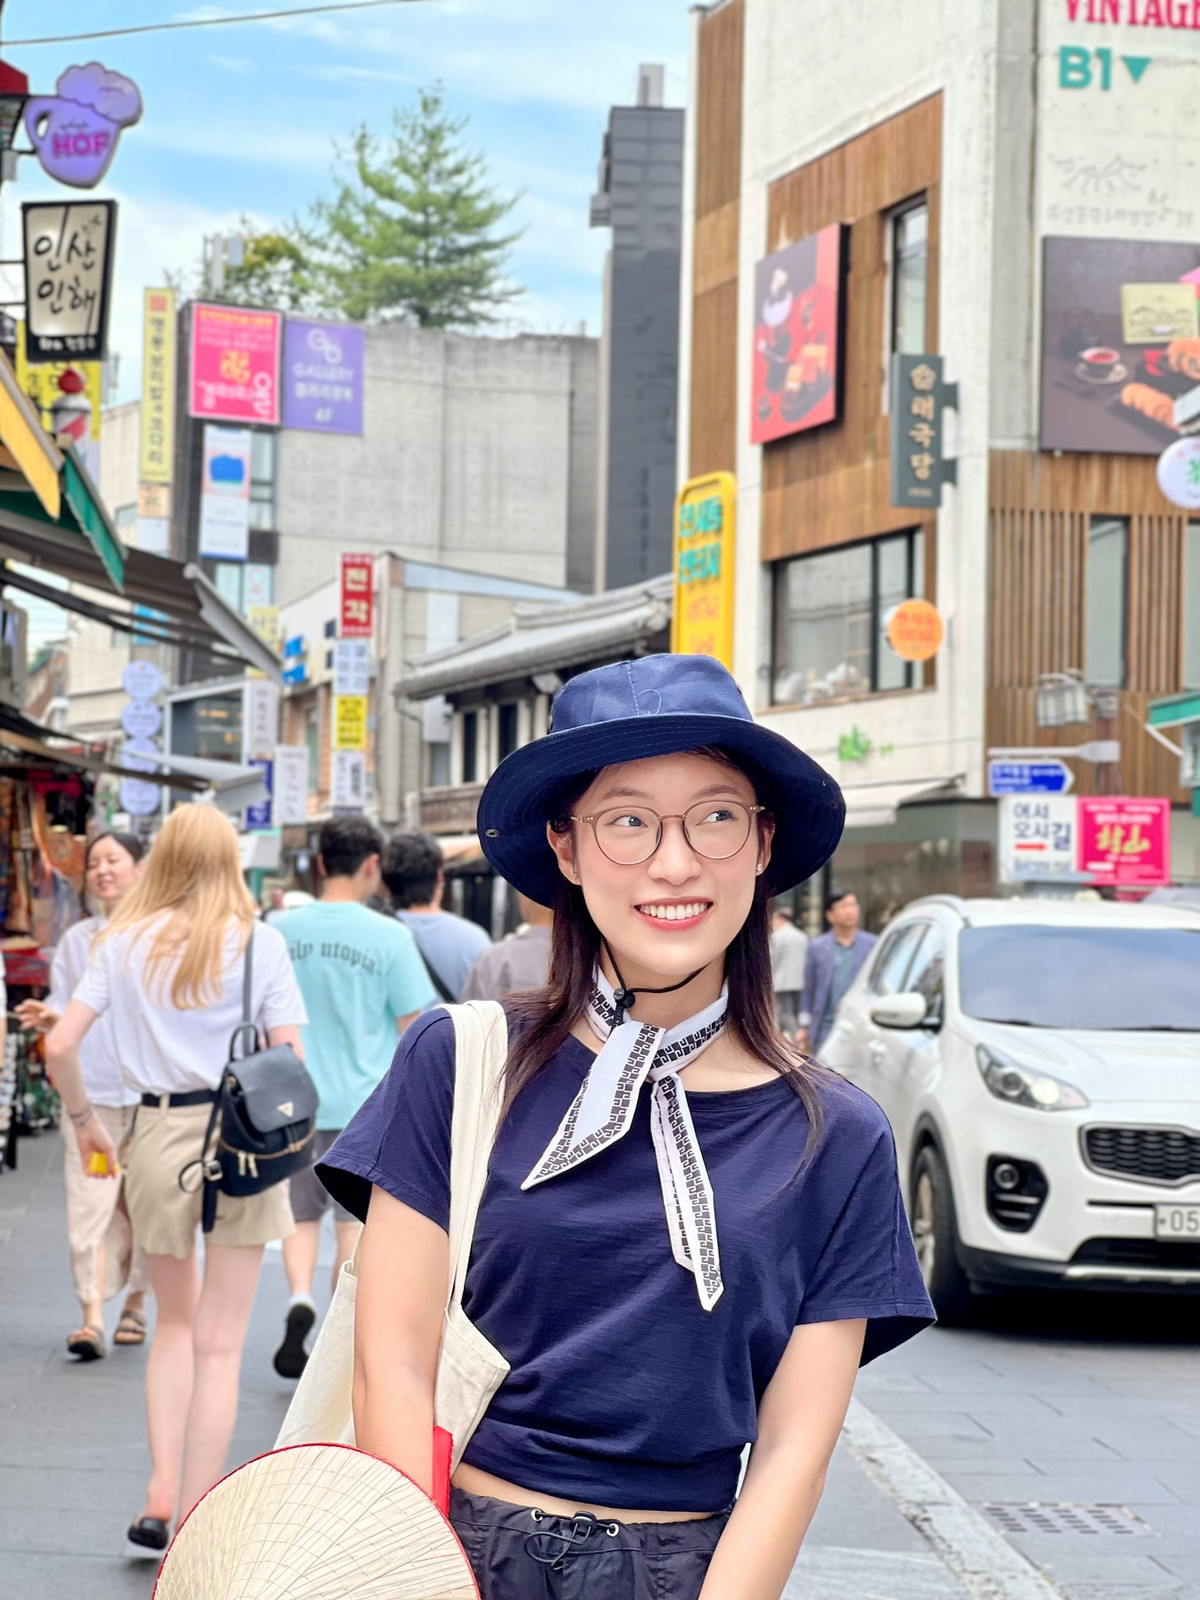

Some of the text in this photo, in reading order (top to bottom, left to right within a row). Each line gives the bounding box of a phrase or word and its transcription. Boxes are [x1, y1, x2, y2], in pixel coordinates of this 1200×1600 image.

[1059, 46, 1112, 91] B1
[53, 131, 109, 158] HOF
[34, 207, 97, 272] 인산
[37, 275, 97, 328] 인해
[293, 362, 355, 382] GALLERY
[1013, 802, 1050, 819] 어서
[1170, 1210, 1200, 1232] 05
